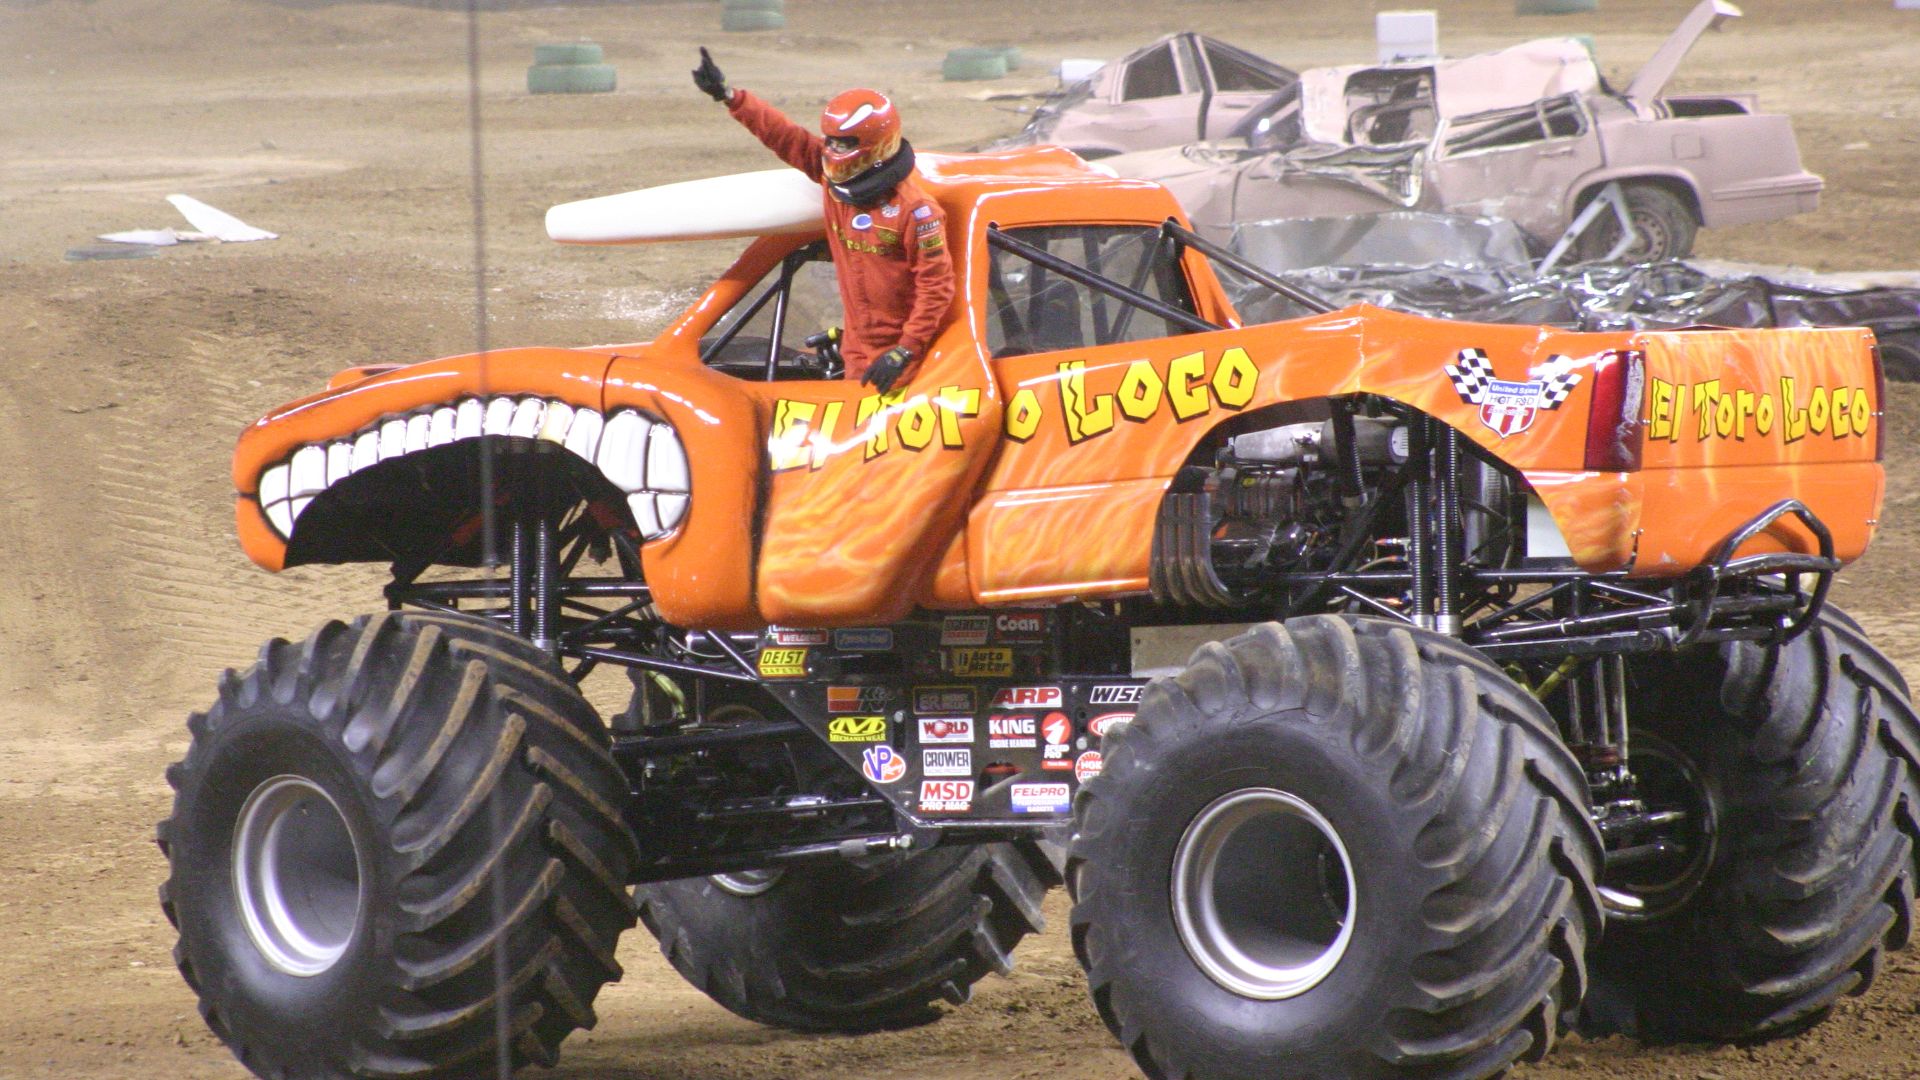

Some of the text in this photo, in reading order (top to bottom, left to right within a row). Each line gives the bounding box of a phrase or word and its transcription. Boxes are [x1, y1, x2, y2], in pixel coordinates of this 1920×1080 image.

[1491, 384, 1518, 393] United
[1489, 395, 1512, 405] HOT
[768, 399, 844, 472] El
[1059, 346, 1260, 445] Loco
[1650, 375, 1871, 444] El Toro Loco
[996, 614, 1040, 631] Coan
[762, 651, 804, 664] DEIST
[992, 688, 1061, 705] ARP
[923, 720, 969, 738] WORLD
[989, 719, 1035, 734] KING
[864, 745, 893, 781] VP
[925, 751, 969, 768] CROWER
[923, 782, 970, 800] MSD
[1013, 787, 1066, 797] FEL-PRO
